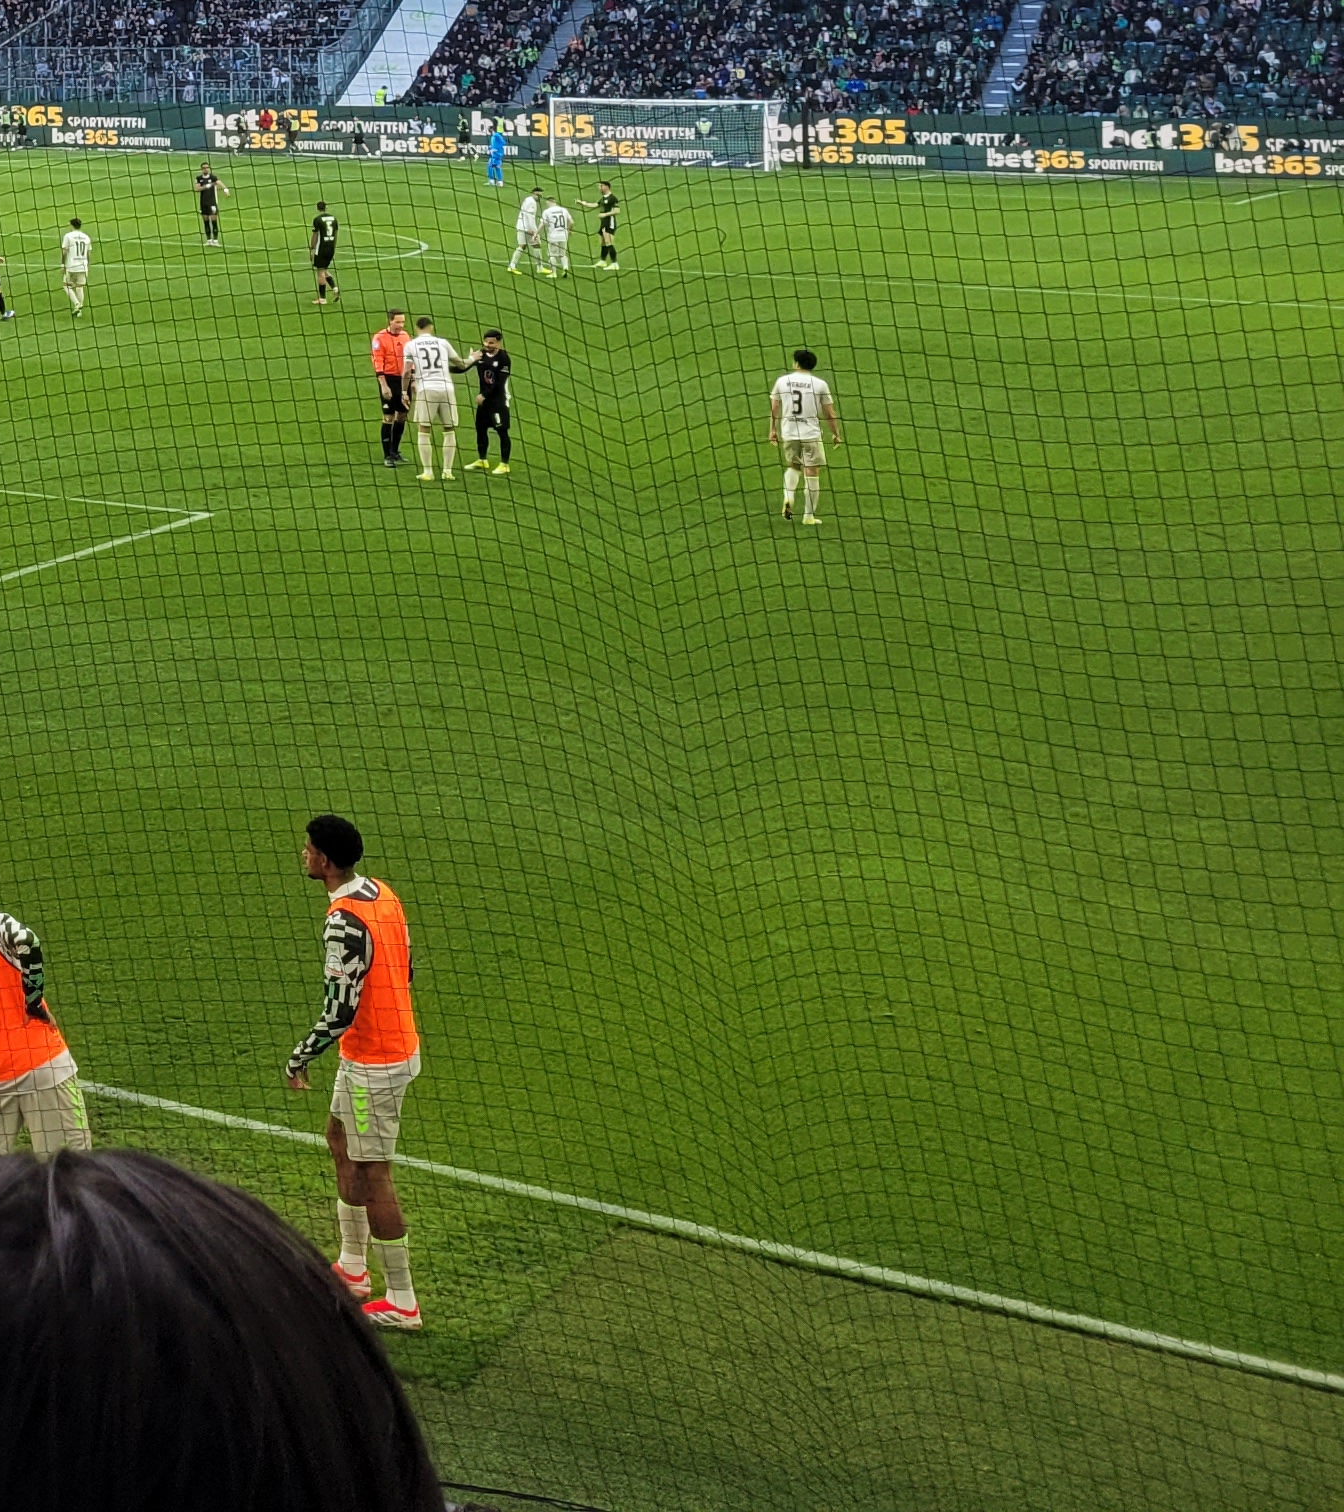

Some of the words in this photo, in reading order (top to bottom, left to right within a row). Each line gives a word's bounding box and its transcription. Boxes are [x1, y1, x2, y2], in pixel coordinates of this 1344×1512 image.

[52, 128, 118, 145] bet365
[120, 136, 171, 147] SPORTWETTEN
[380, 135, 457, 154] bet365
[1102, 121, 1260, 152] bet35
[564, 139, 648, 157] bet365
[856, 155, 926, 167] SPORTWETTEN
[986, 148, 1086, 169] bet365
[1088, 158, 1164, 172] SPORTWETTEN
[1215, 152, 1322, 176] bet365
[552, 215, 565, 229] 20
[75, 241, 86, 257] 10
[418, 347, 443, 370] 32
[791, 390, 803, 415] 3
